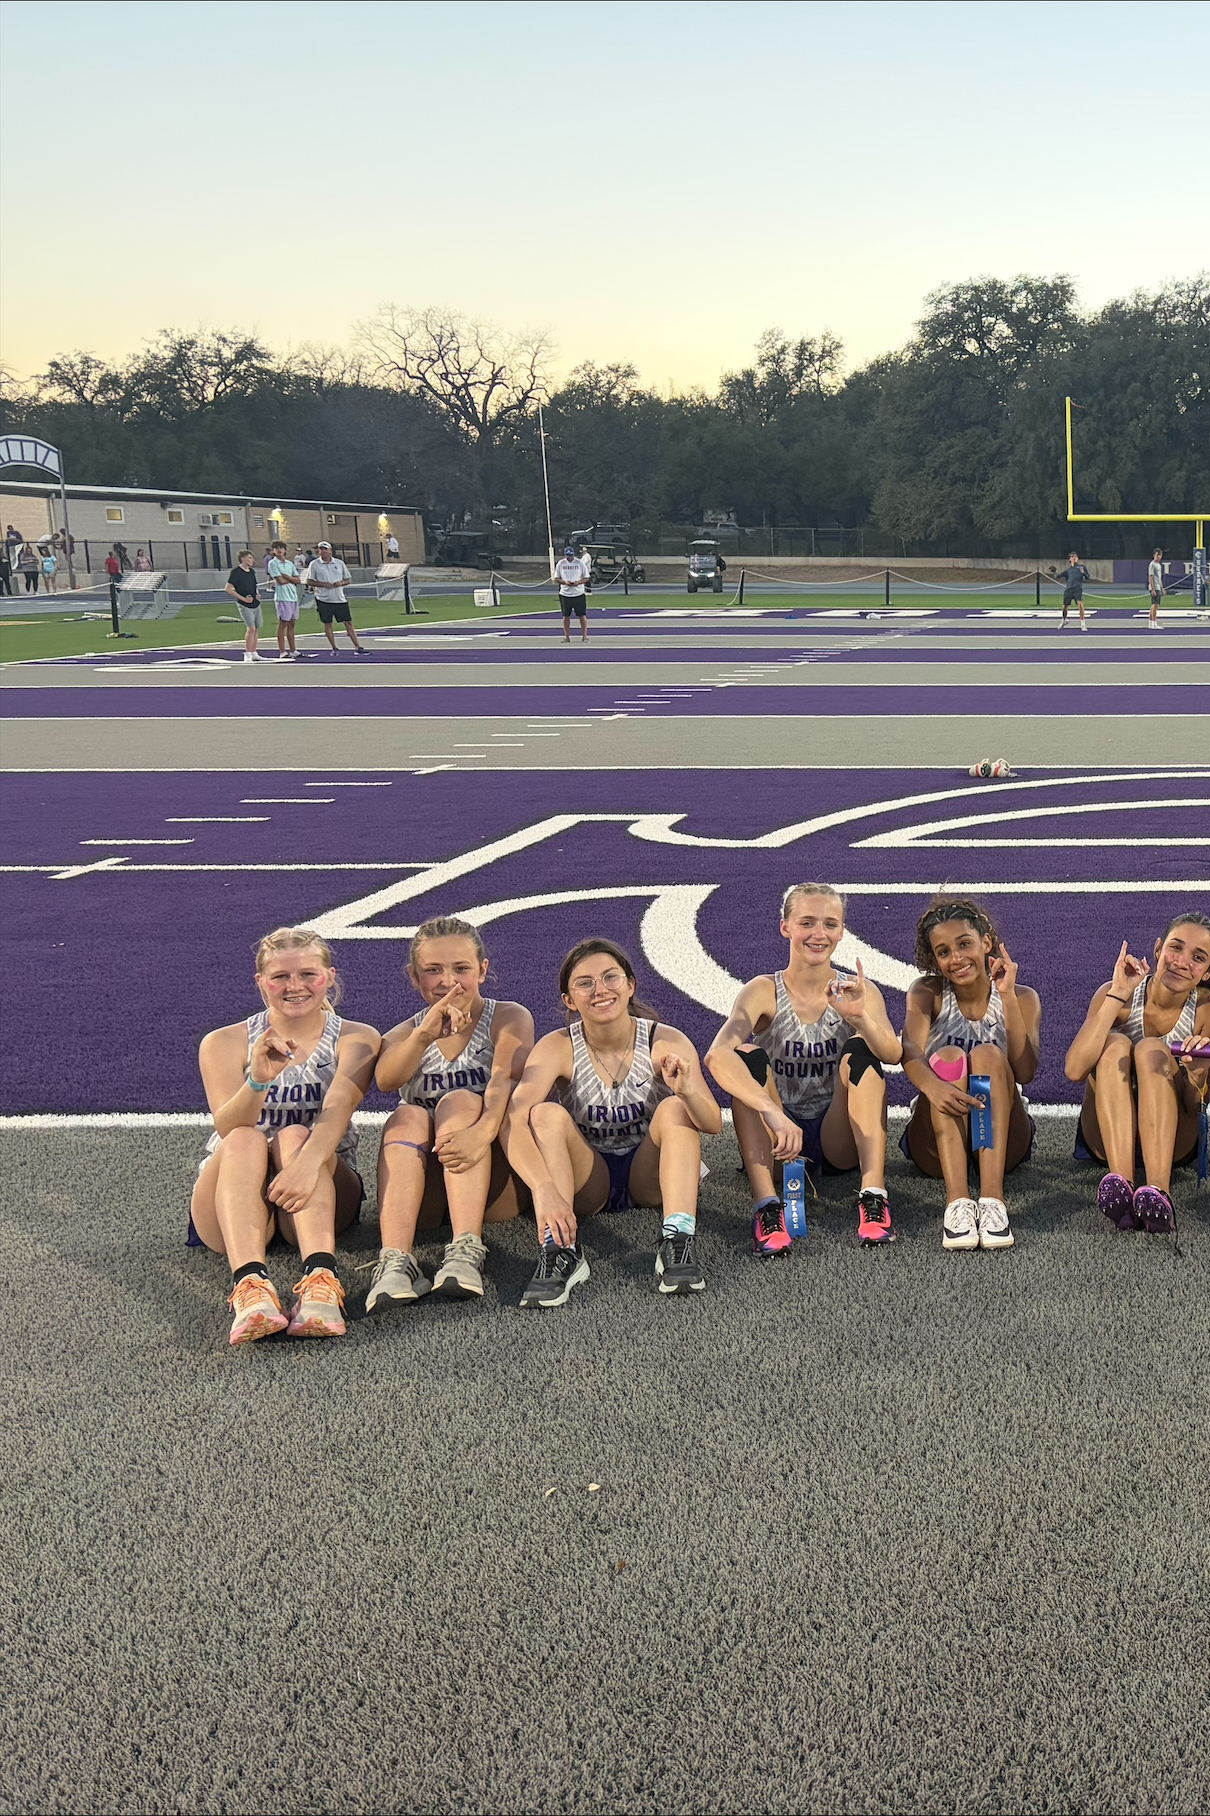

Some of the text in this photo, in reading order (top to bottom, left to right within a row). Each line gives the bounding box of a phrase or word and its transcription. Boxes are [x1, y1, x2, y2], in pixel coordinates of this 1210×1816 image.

[785, 1038, 837, 1058] IRION
[423, 1066, 487, 1091] IRION
[774, 1059, 837, 1078] COUNT
[264, 1082, 322, 1103] RION
[587, 1101, 646, 1124] IRION
[978, 1111, 986, 1141] PLACE
[791, 1200, 799, 1229] PLACE
